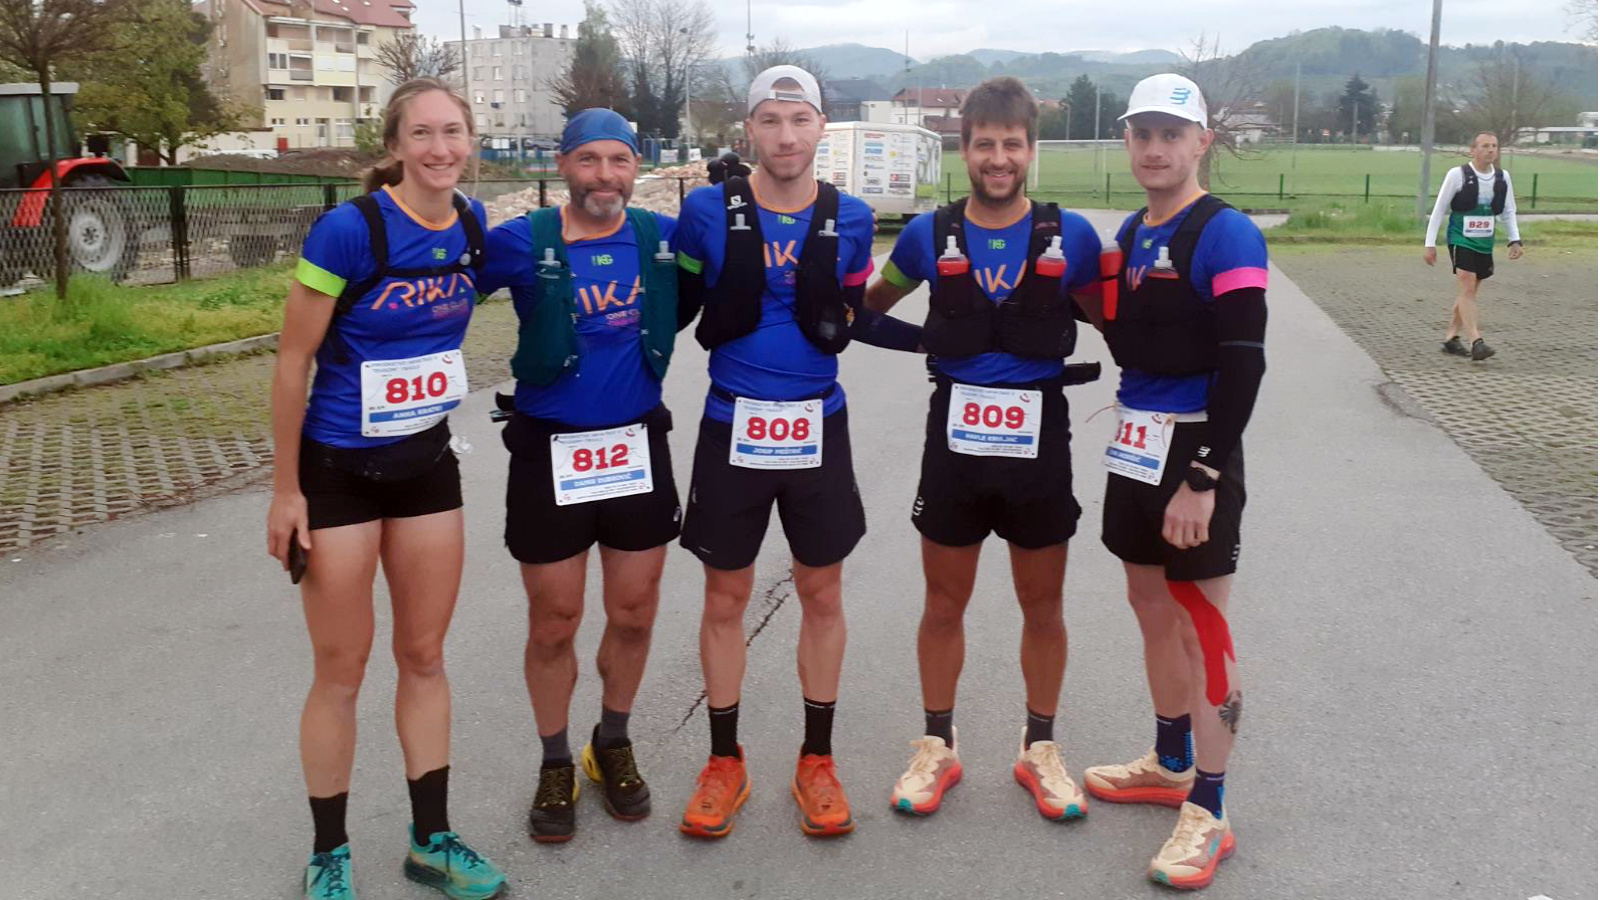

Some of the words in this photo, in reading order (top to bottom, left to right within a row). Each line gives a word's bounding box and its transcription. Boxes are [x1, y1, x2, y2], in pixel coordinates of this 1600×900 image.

[386, 371, 447, 404] 810
[746, 416, 809, 441] 808
[963, 402, 1024, 429] 809
[573, 443, 629, 472] 812
